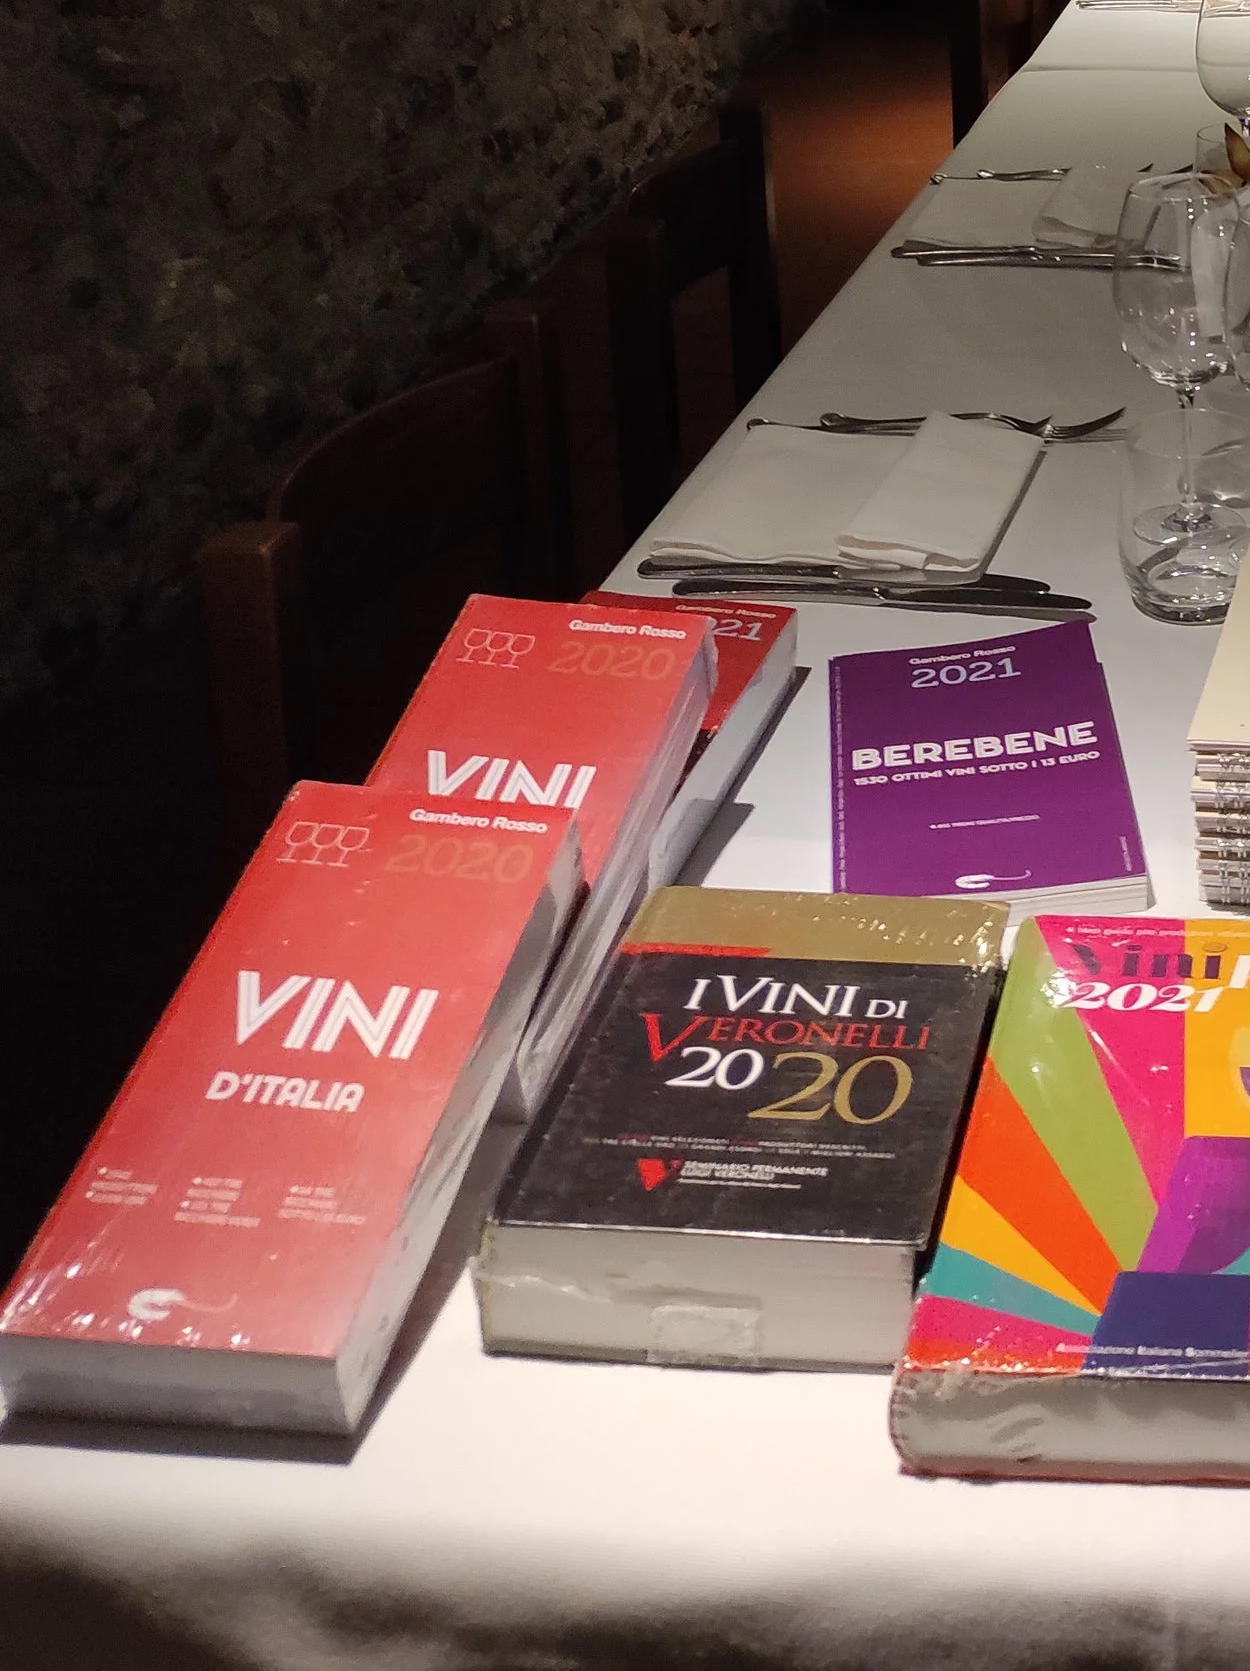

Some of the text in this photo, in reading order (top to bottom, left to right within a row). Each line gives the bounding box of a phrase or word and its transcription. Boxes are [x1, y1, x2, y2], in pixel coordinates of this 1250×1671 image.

[675, 603, 776, 619] Gambero Rosso
[569, 619, 686, 639] Gambero Rosso
[712, 619, 763, 641] 21
[548, 641, 675, 679] 2020
[909, 645, 1016, 665] Gambero Rosso
[911, 658, 1021, 688] 2021
[852, 721, 1098, 770] BEREBENE
[425, 750, 597, 810] VINI
[945, 767, 975, 776] VINI
[980, 762, 1027, 774] SOTTO
[1040, 758, 1057, 766] 13
[1059, 751, 1100, 764] EURO
[409, 809, 548, 833] Gambero Rosso
[384, 834, 534, 883] 2020
[717, 974, 861, 1017] VINI
[865, 999, 908, 1019] DI
[1064, 983, 1230, 1012] 2021
[236, 970, 439, 1059] VINI
[642, 1013, 931, 1062] VERONELLI
[205, 1071, 365, 1112] D'ITALIA
